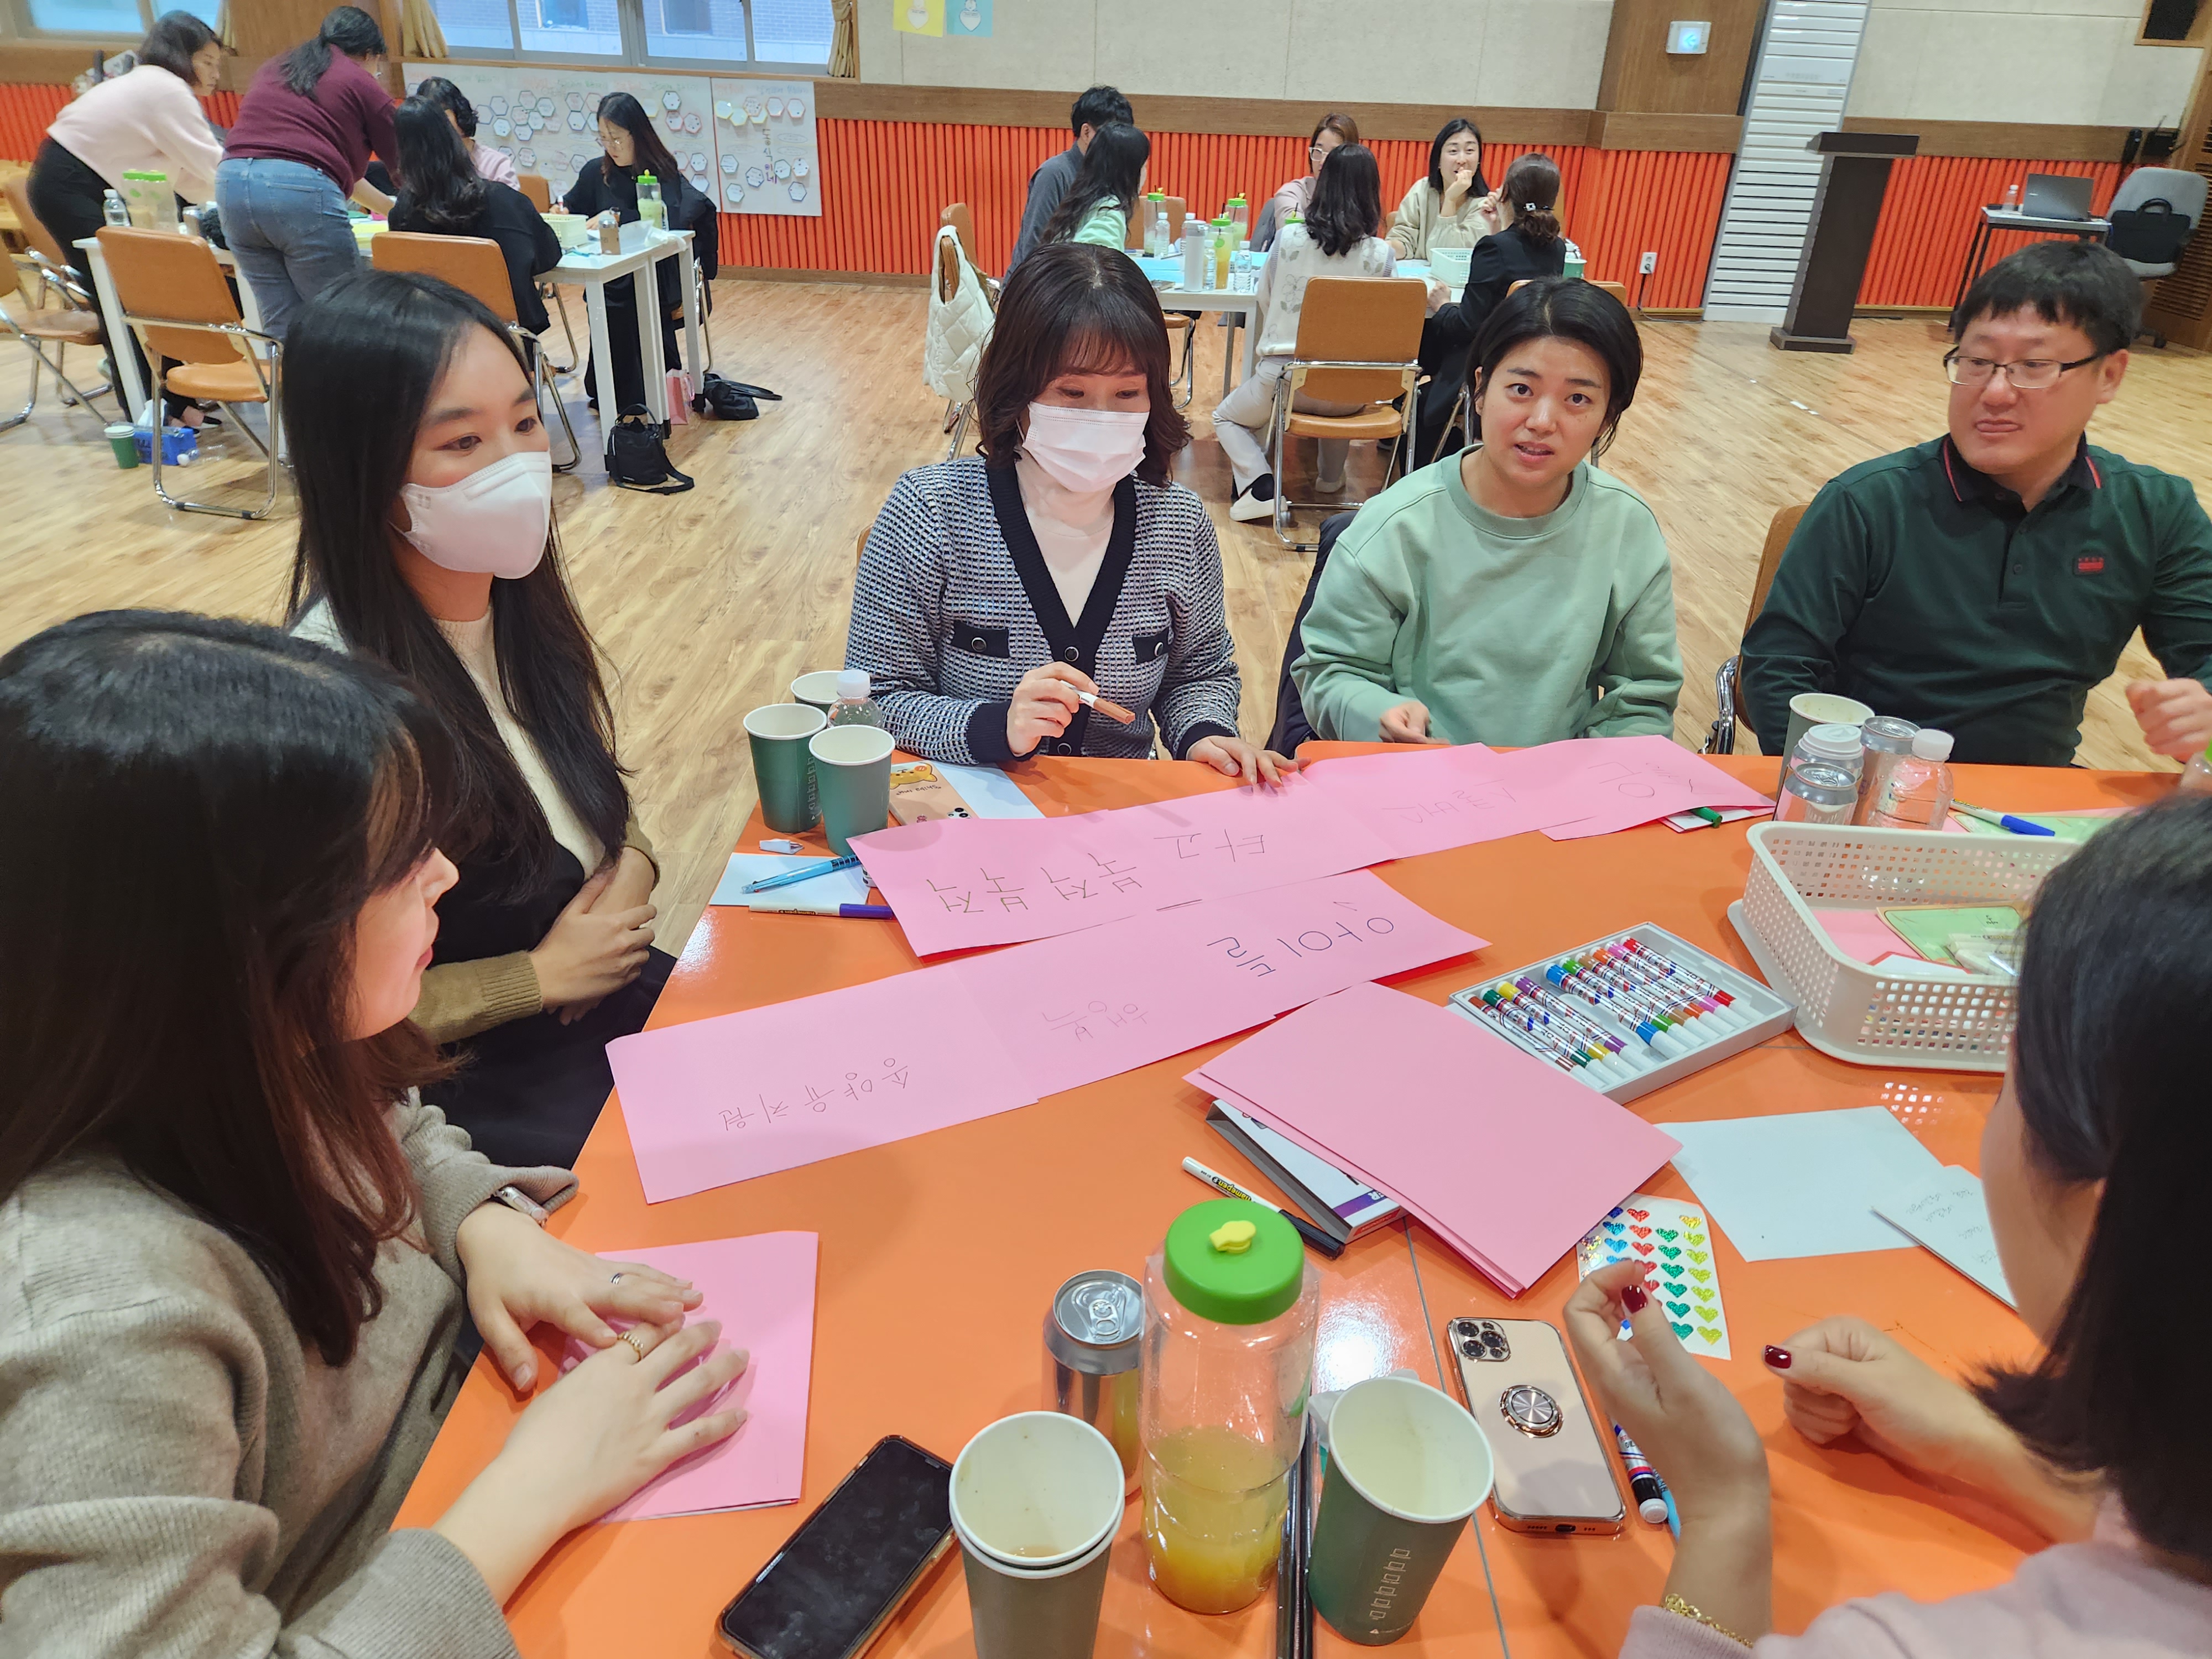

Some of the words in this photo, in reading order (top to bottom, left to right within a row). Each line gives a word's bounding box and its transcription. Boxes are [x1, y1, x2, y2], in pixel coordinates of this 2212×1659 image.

[1381, 779, 1516, 823] 스쿨버스
[1154, 829, 1264, 862] 타고
[718, 1058, 907, 1131] 송양유치원
[1042, 1001, 1148, 1041] 행복
[1207, 917, 1394, 977] 아이들
